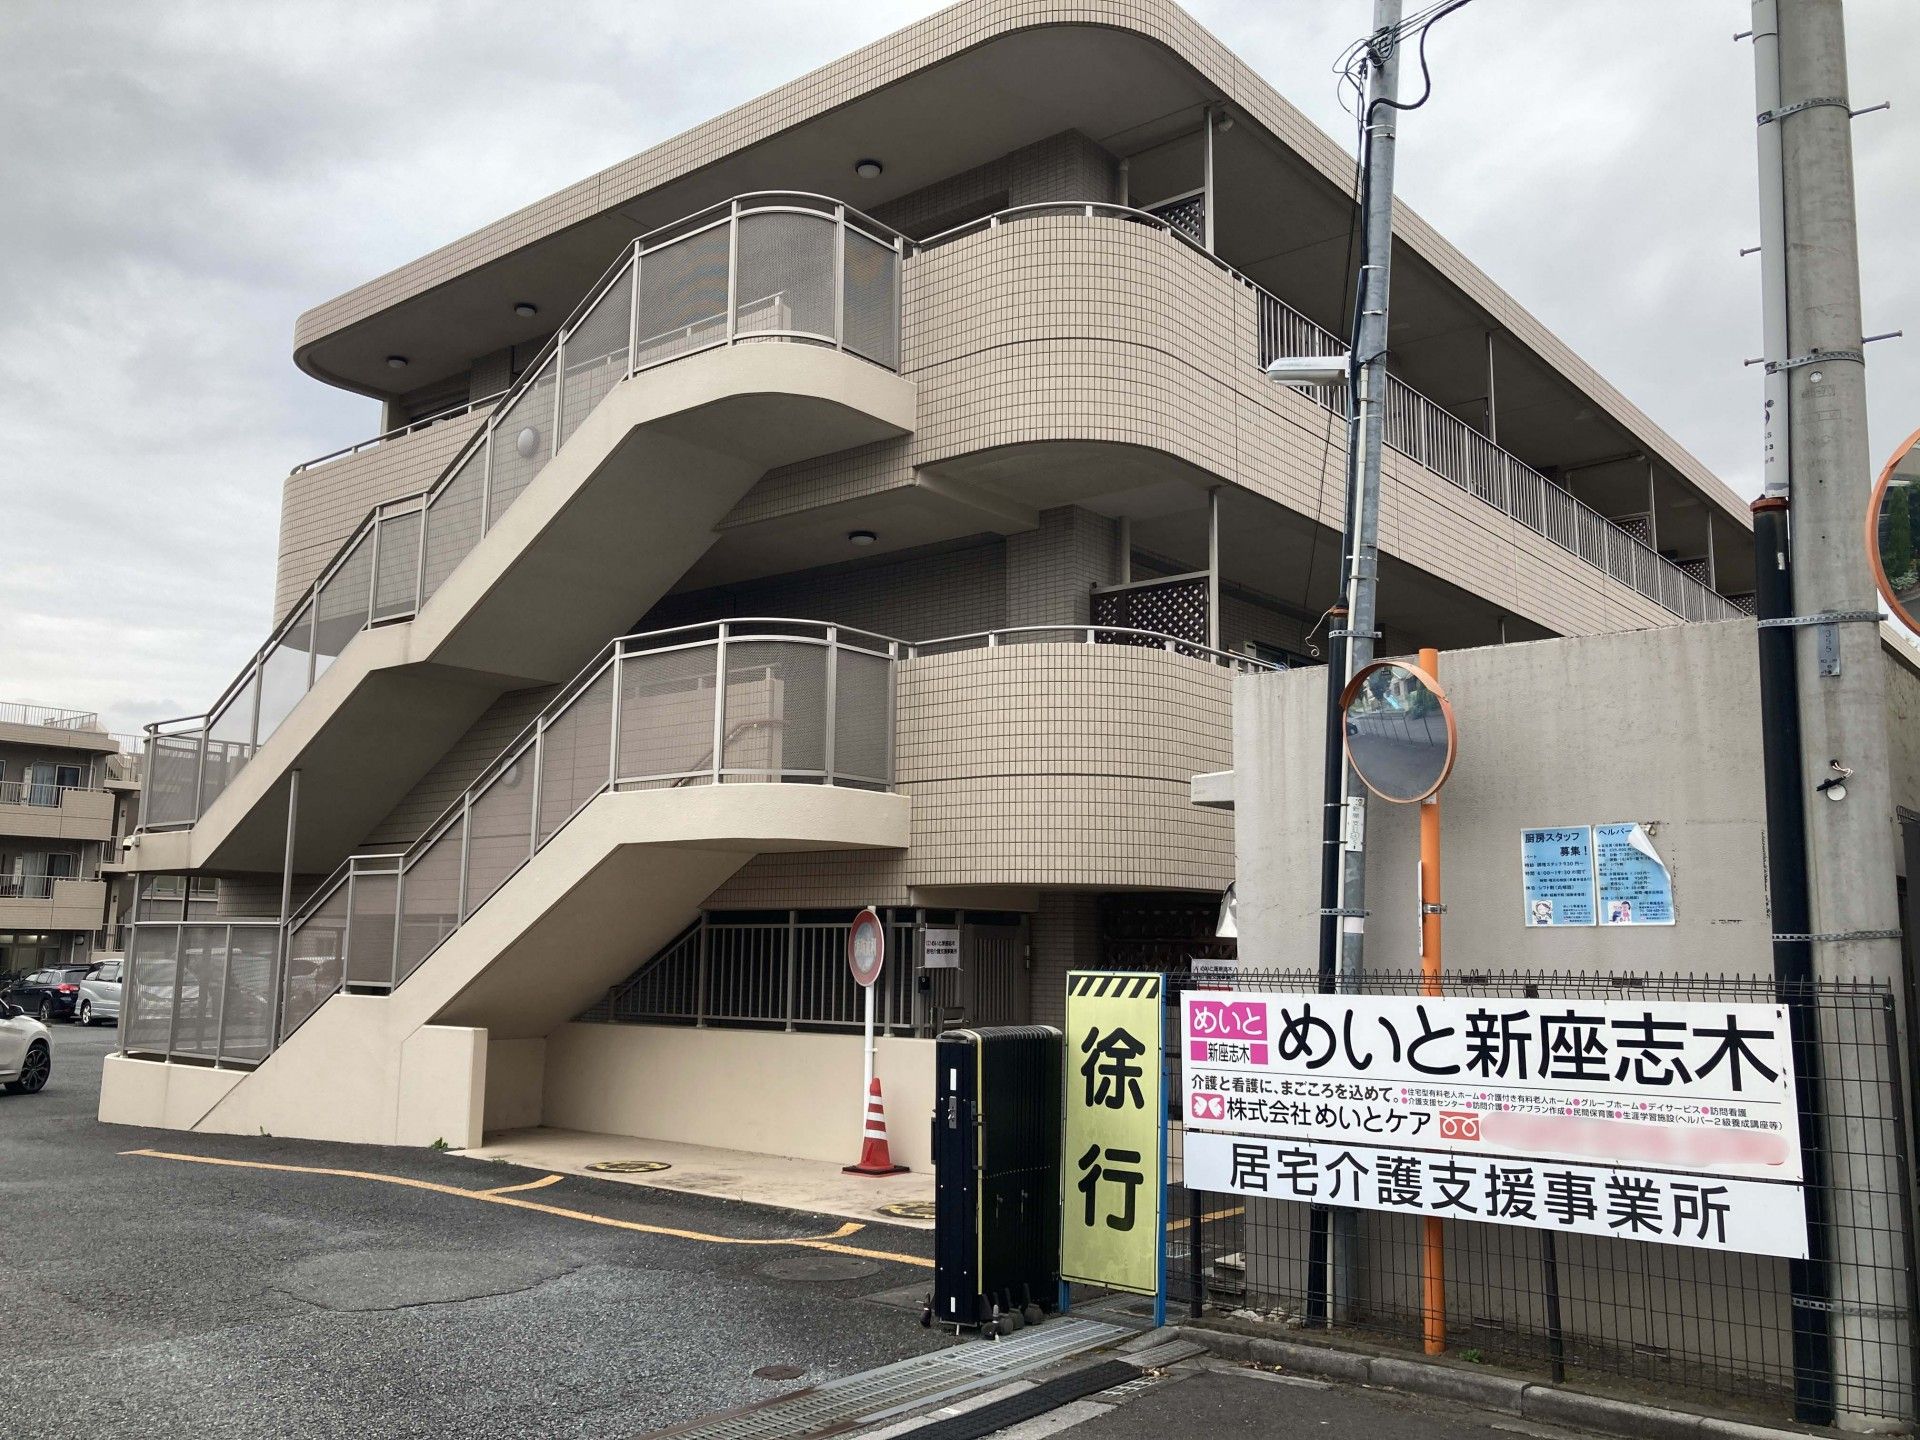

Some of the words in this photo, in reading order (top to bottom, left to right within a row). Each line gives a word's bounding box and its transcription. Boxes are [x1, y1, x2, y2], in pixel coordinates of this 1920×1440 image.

[1525, 832, 1580, 844] 厨房スタッフ
[1194, 1007, 1263, 1035] めいと
[1208, 1042, 1250, 1064] 新座志木
[1278, 1002, 1779, 1092] めいと新座志木
[1191, 1074, 1399, 1104] 介護と看護に、まごころを込めて。
[1227, 1096, 1431, 1136] 株式会社めいとケア
[1580, 1098, 1639, 1110] グループホーム
[1648, 1102, 1701, 1114] デイサービス
[1710, 1106, 1747, 1118] 訪問看護
[1078, 1026, 1146, 1232] 徐行
[1230, 1142, 1731, 1244] 居宅介護支援事業所
